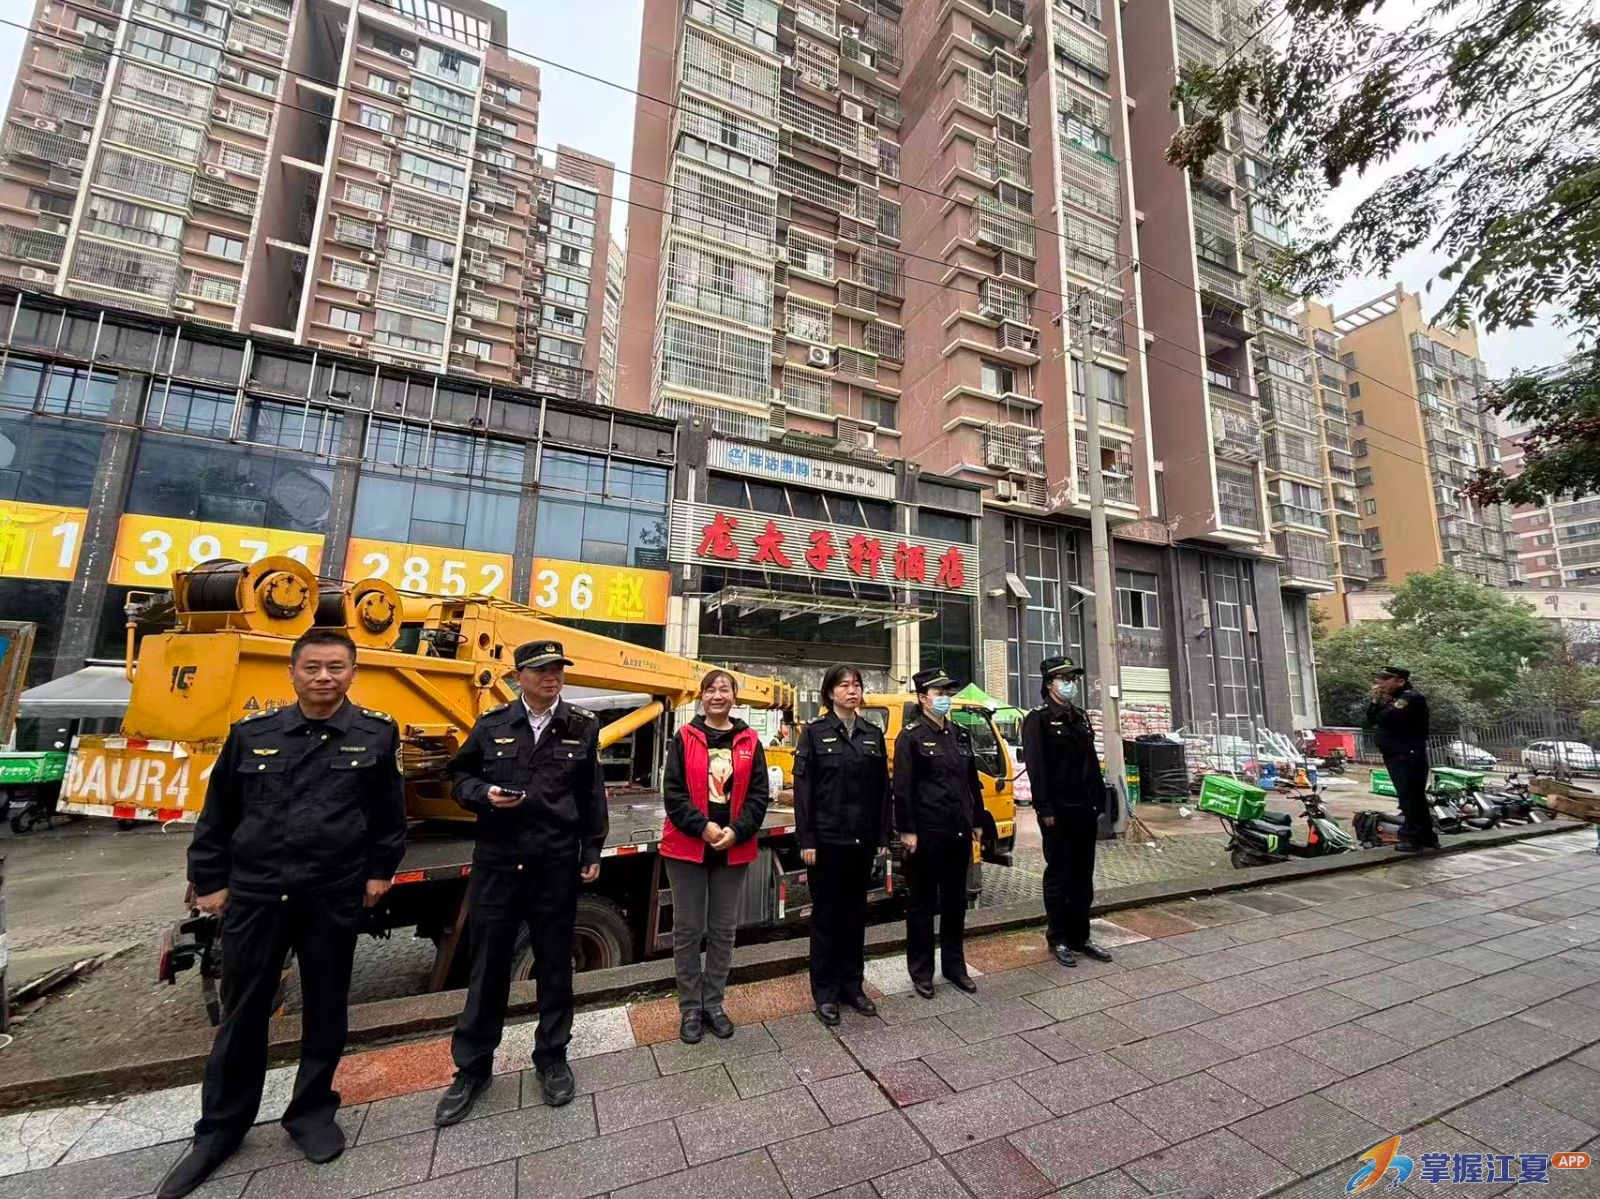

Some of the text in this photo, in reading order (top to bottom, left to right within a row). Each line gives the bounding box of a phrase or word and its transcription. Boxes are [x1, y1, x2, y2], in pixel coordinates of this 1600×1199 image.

[696, 512, 965, 589] 龙太子轩酒店
